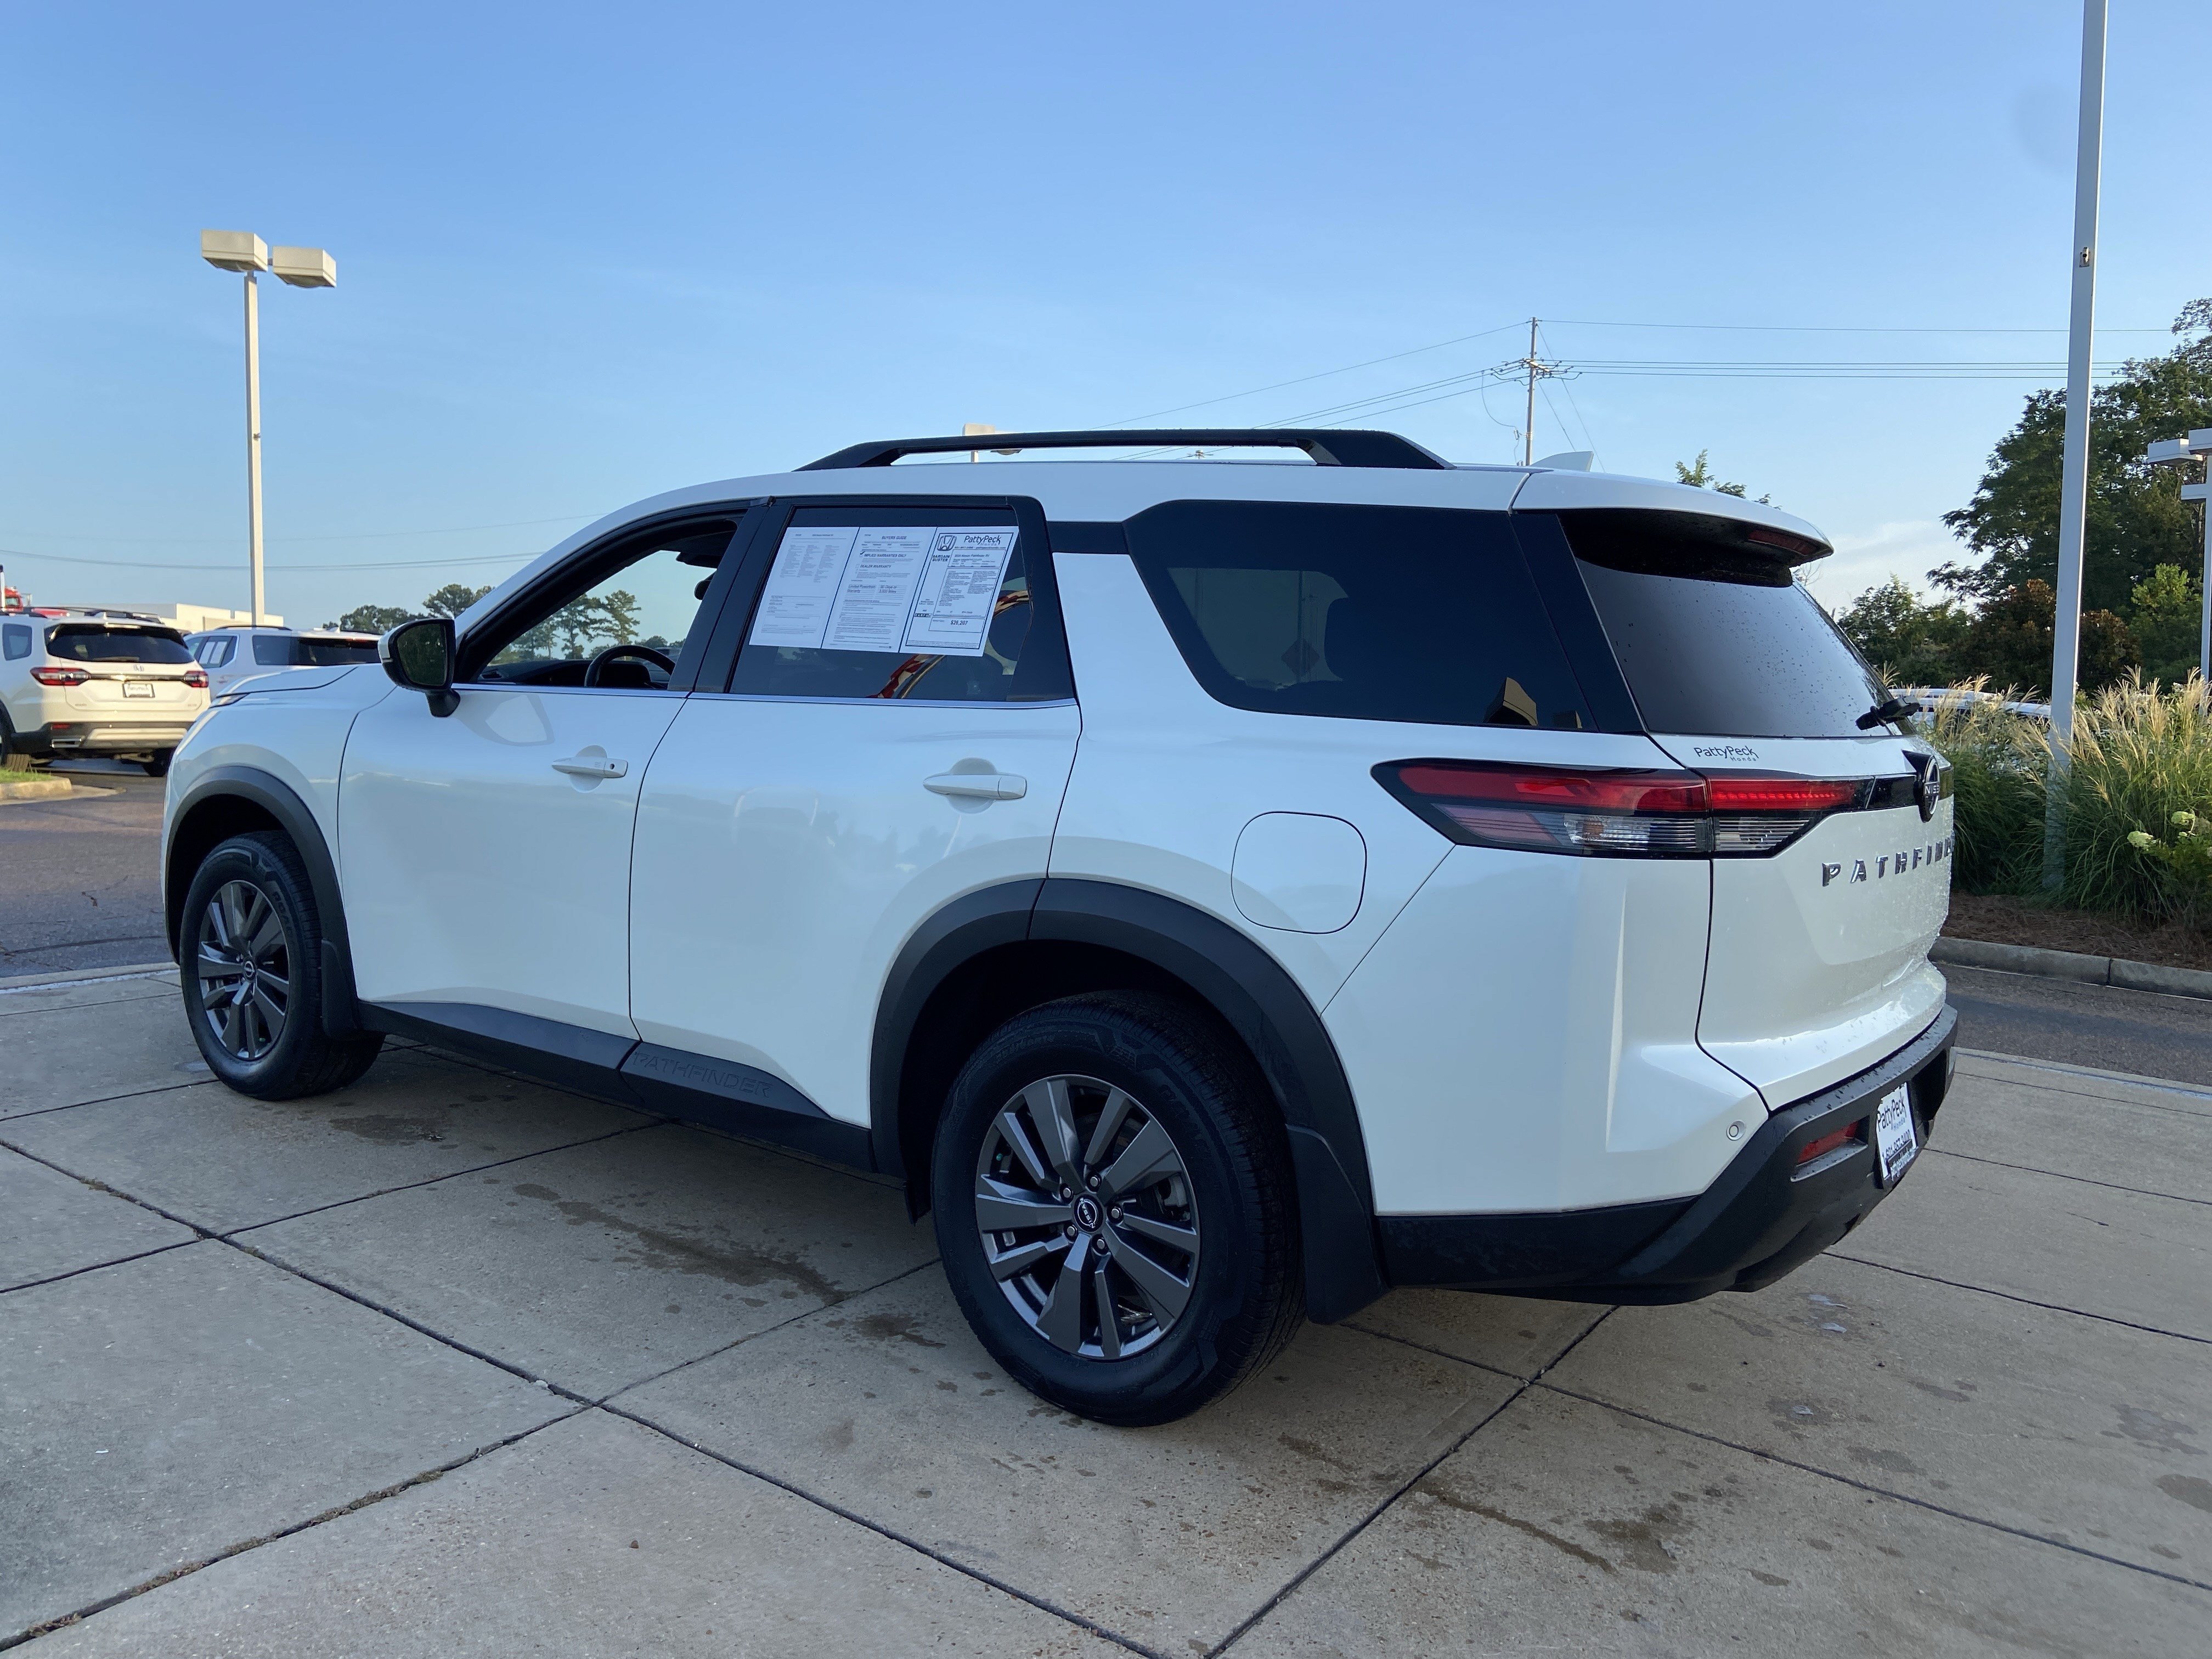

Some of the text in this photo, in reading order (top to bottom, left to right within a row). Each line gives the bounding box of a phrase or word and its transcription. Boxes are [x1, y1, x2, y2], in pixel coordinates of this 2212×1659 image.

[964, 535, 1002, 545] PattyPeck
[1694, 745, 1759, 759] PattyPeck
[633, 1051, 773, 1098] PATHFINDER
[1877, 1091, 1907, 1132] PattyPeck
